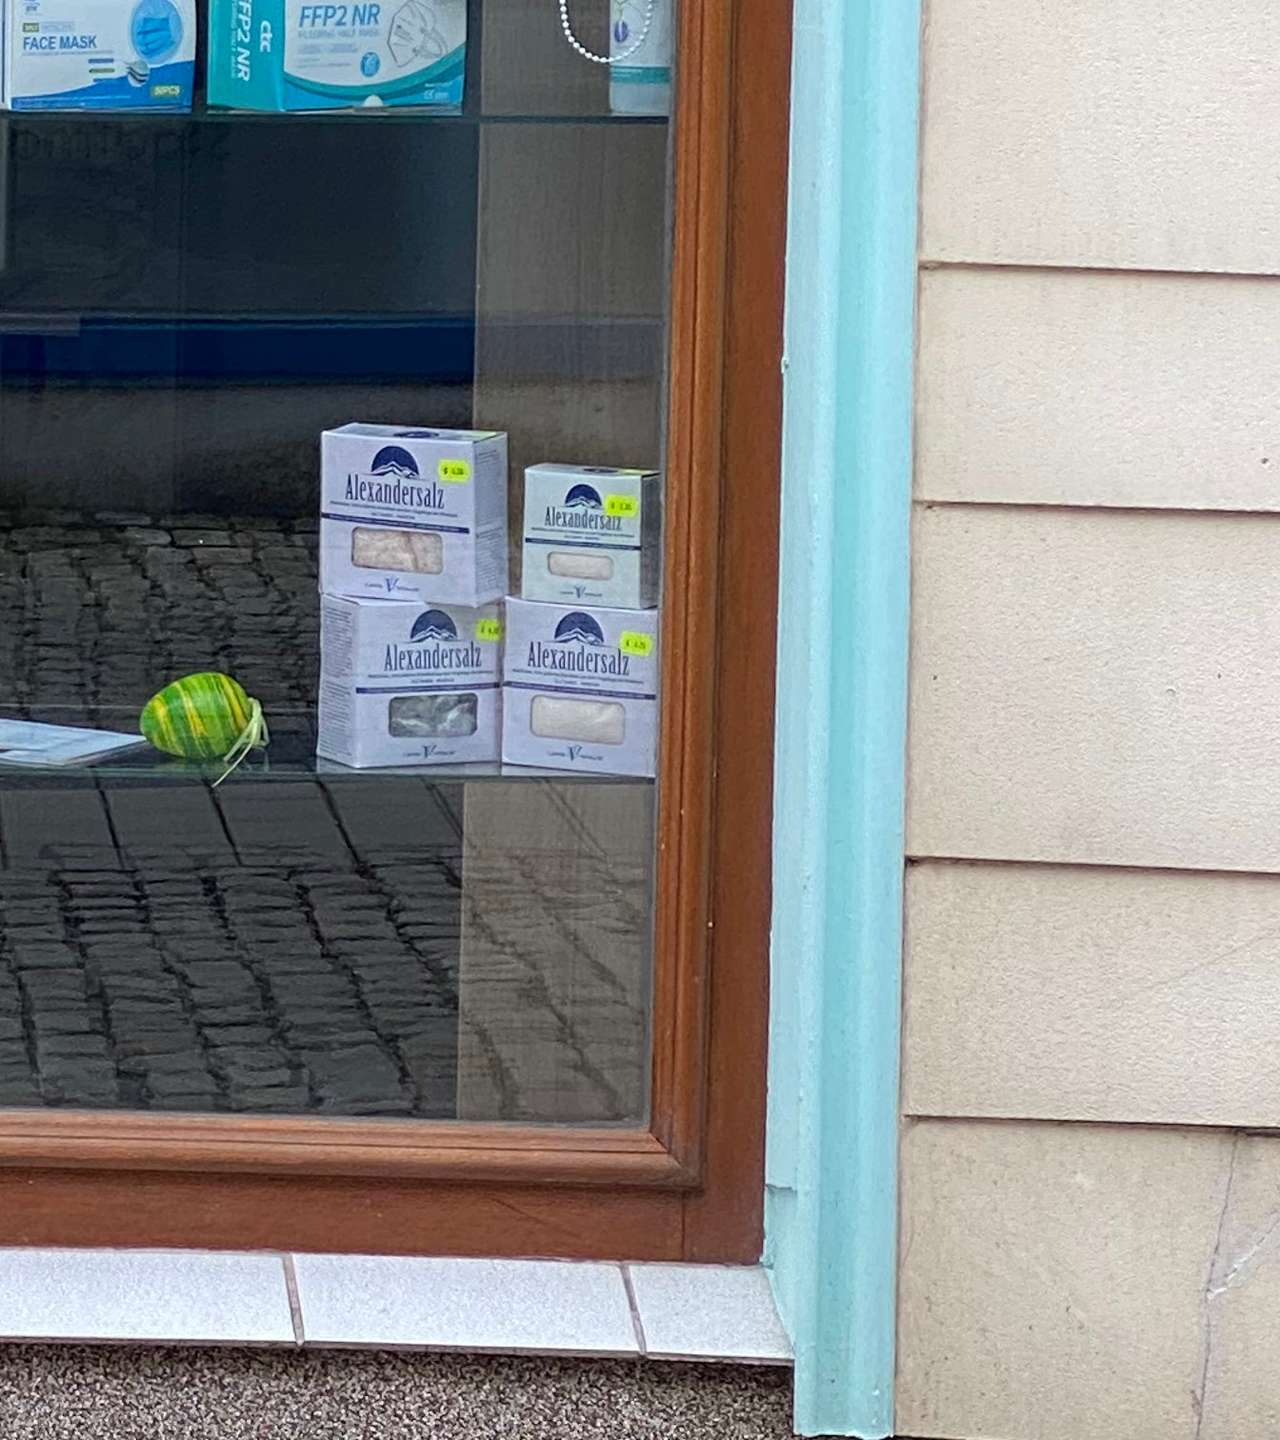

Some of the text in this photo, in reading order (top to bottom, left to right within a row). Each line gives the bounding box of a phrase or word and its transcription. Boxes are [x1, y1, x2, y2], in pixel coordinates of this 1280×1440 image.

[298, 3, 381, 28] FFP2 NR
[22, 35, 98, 51] FACE MASK
[260, 20, 273, 53] ctc
[237, 45, 252, 82] NR
[344, 473, 446, 510] Alexandersalz
[543, 505, 622, 532] Alexandersalz
[383, 640, 483, 673] Alexandersalz
[527, 641, 631, 677] Alexandersalz
